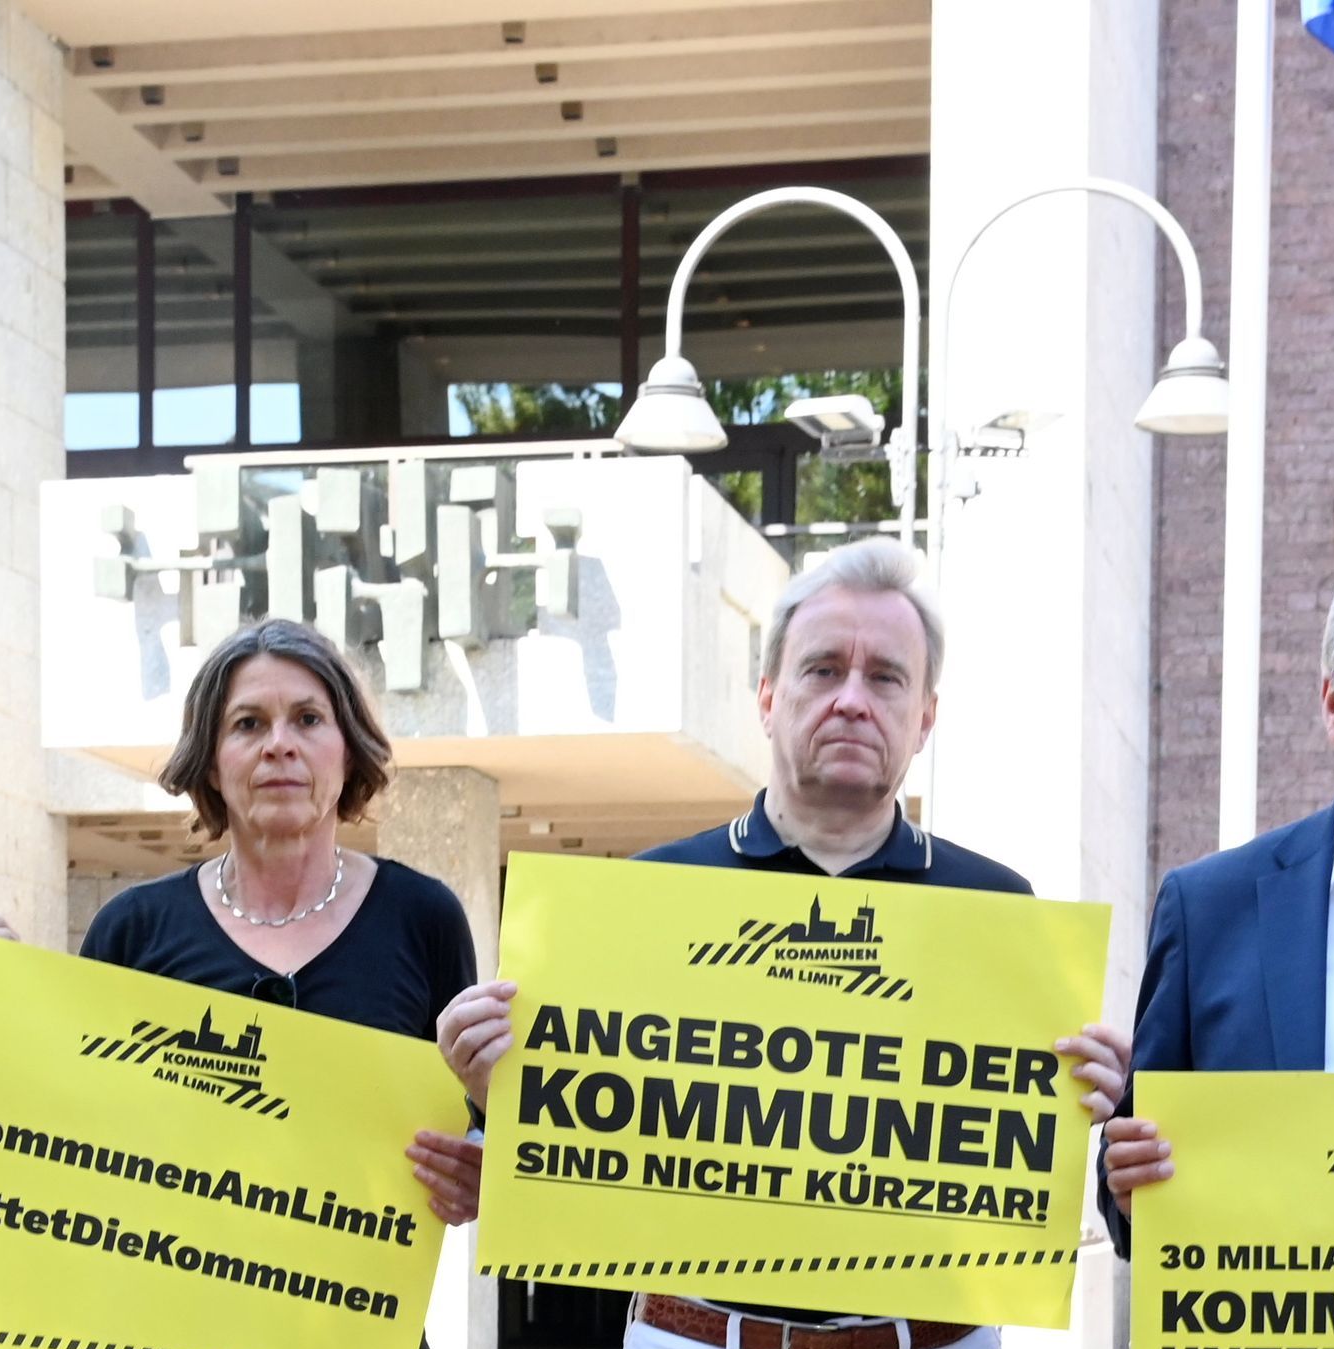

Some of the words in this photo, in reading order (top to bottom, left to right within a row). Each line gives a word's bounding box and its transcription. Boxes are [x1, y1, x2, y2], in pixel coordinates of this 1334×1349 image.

[775, 948, 878, 960] KOMMUNEN
[766, 965, 794, 980] AM
[798, 970, 844, 987] LIMIT
[162, 1051, 261, 1077] KOMMUNEN
[524, 1004, 903, 1083] ANGEBOTE
[921, 1039, 1059, 1097] DER
[153, 1067, 179, 1084] AM
[182, 1075, 226, 1097] LIMIT
[518, 1064, 1057, 1173] KOMMUNEN
[515, 1141, 629, 1182] SIND
[642, 1153, 793, 1198] NICHT
[804, 1162, 1050, 1223] KÜRZBAR!
[1160, 1244, 1206, 1270] 30
